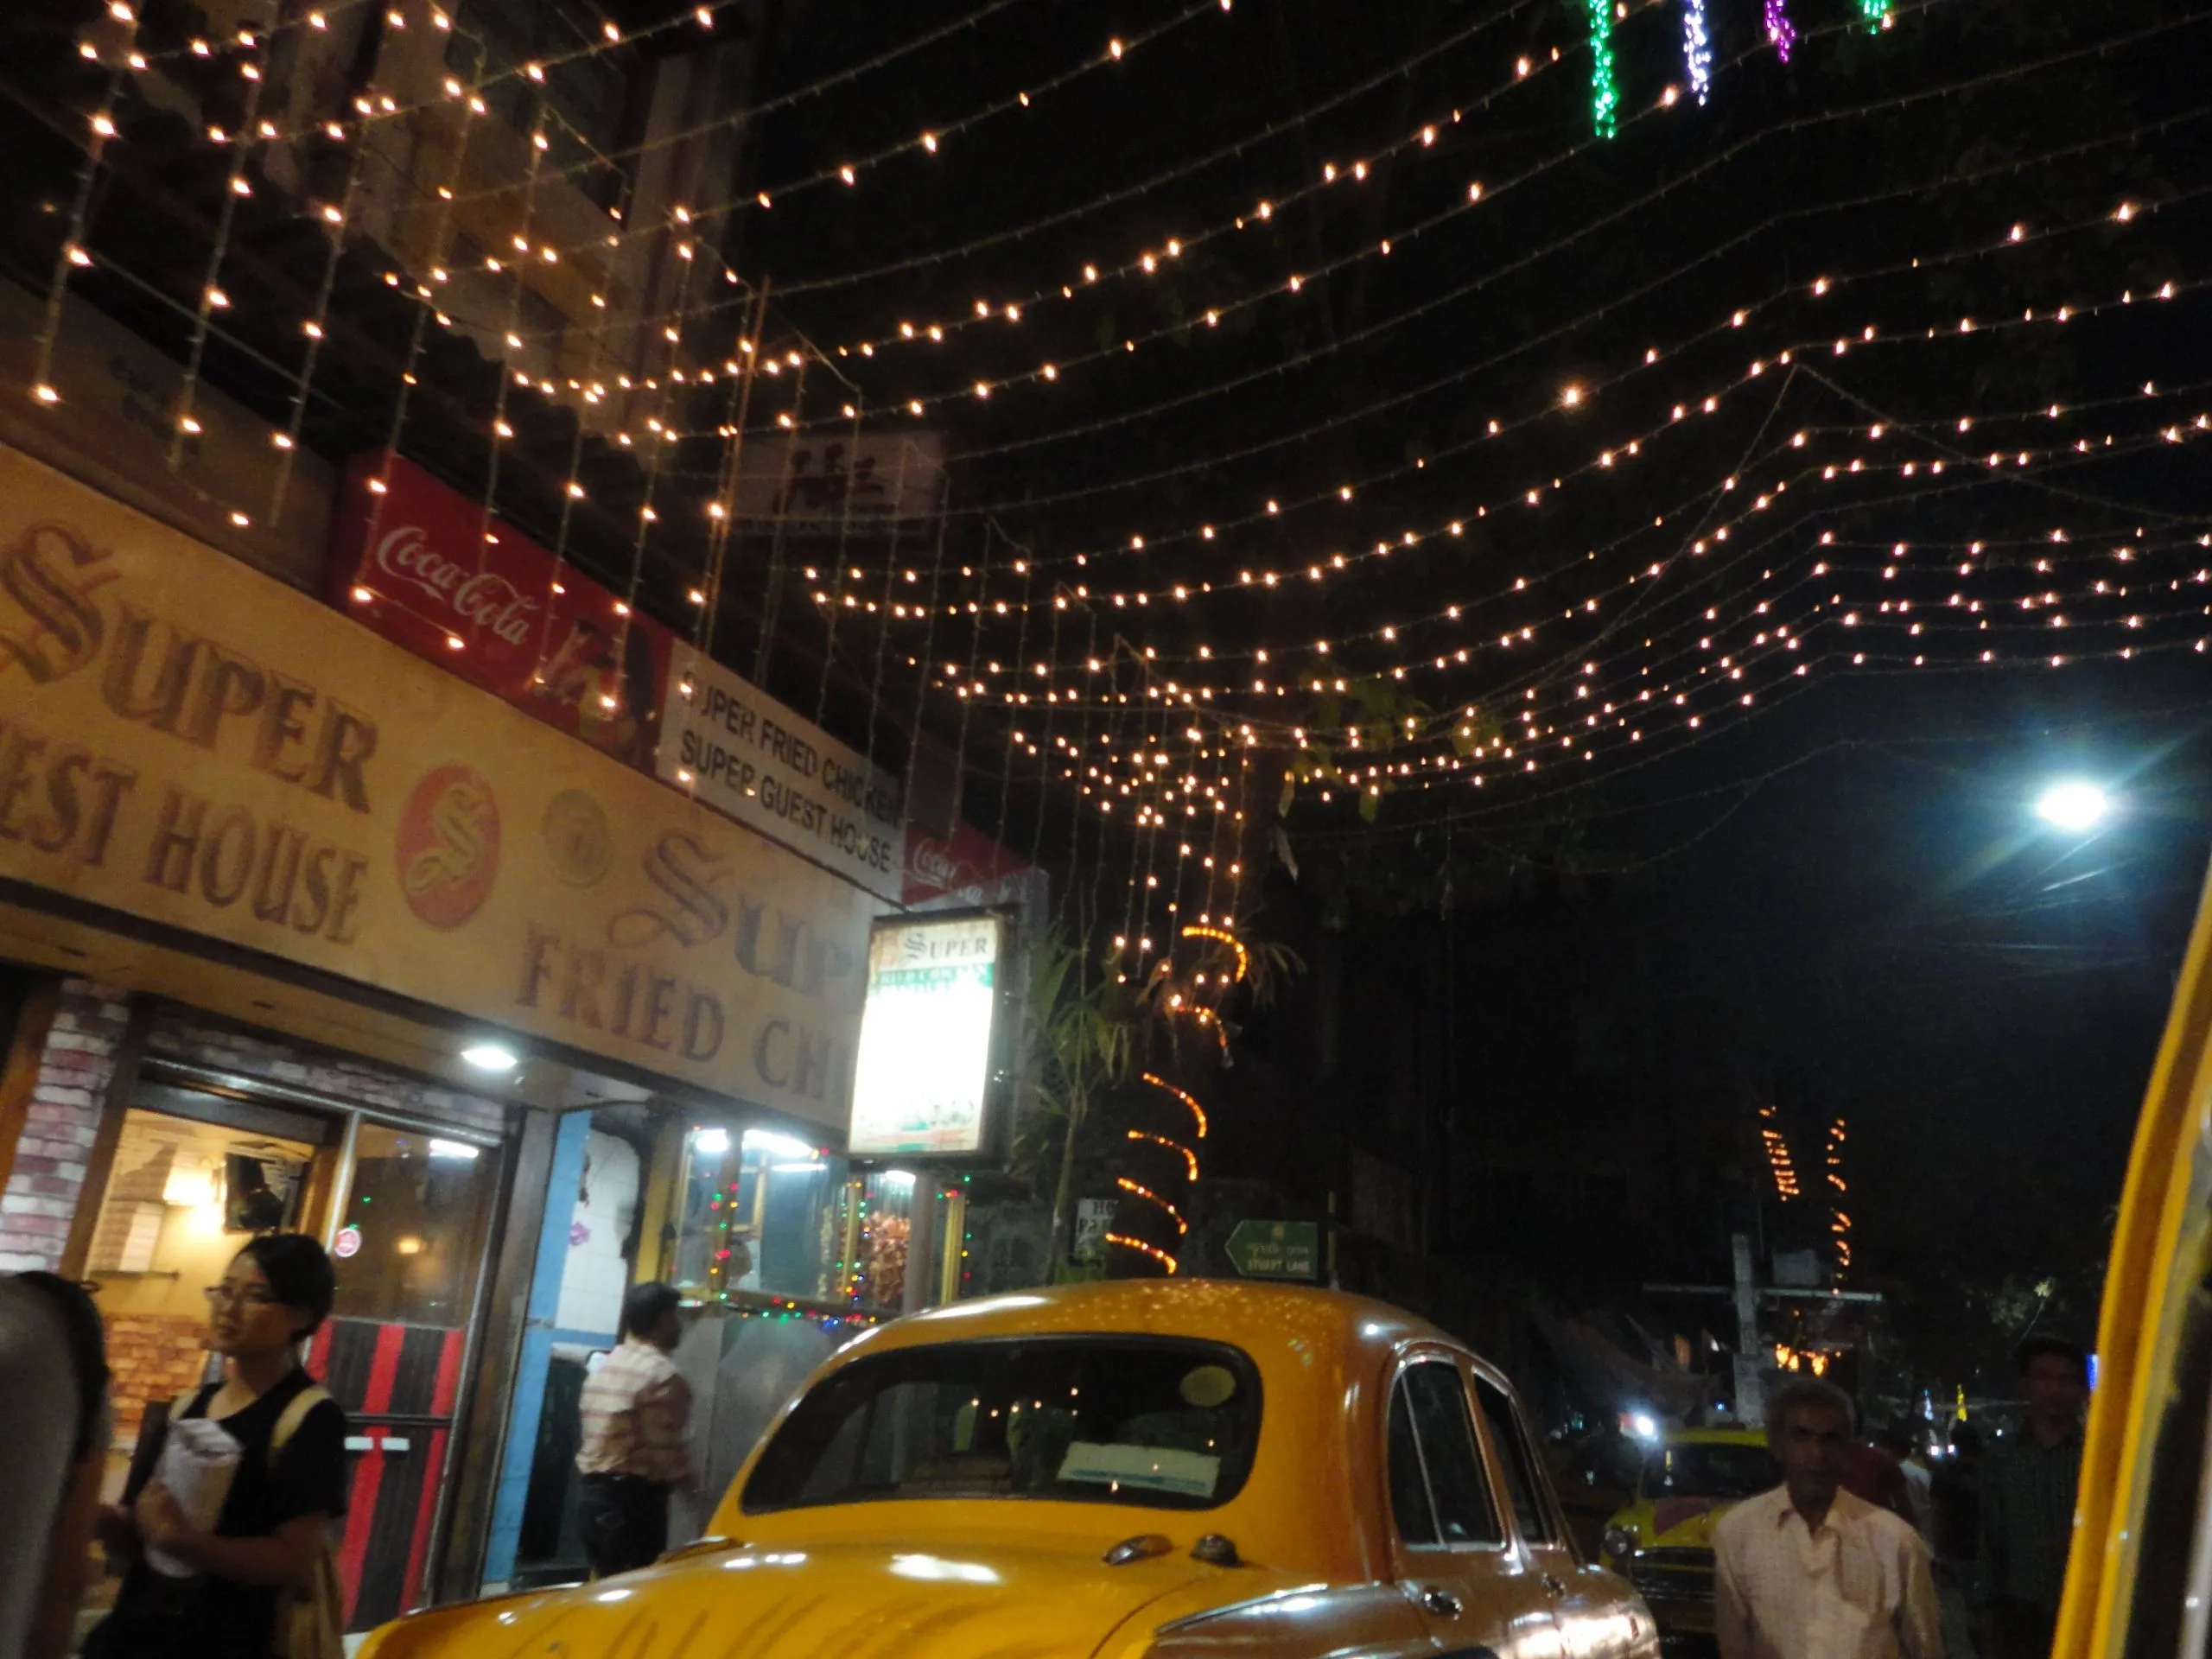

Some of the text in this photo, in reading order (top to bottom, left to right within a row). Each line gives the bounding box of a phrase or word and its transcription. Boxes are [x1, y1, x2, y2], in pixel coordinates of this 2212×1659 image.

[0, 524, 378, 814] SUPER
[680, 729, 893, 874] SUPER GUEST HOUSE
[759, 718, 818, 779] FRIED
[144, 780, 368, 945] HOUSE
[514, 921, 726, 1063] FRIED
[904, 931, 988, 961] SUPER
